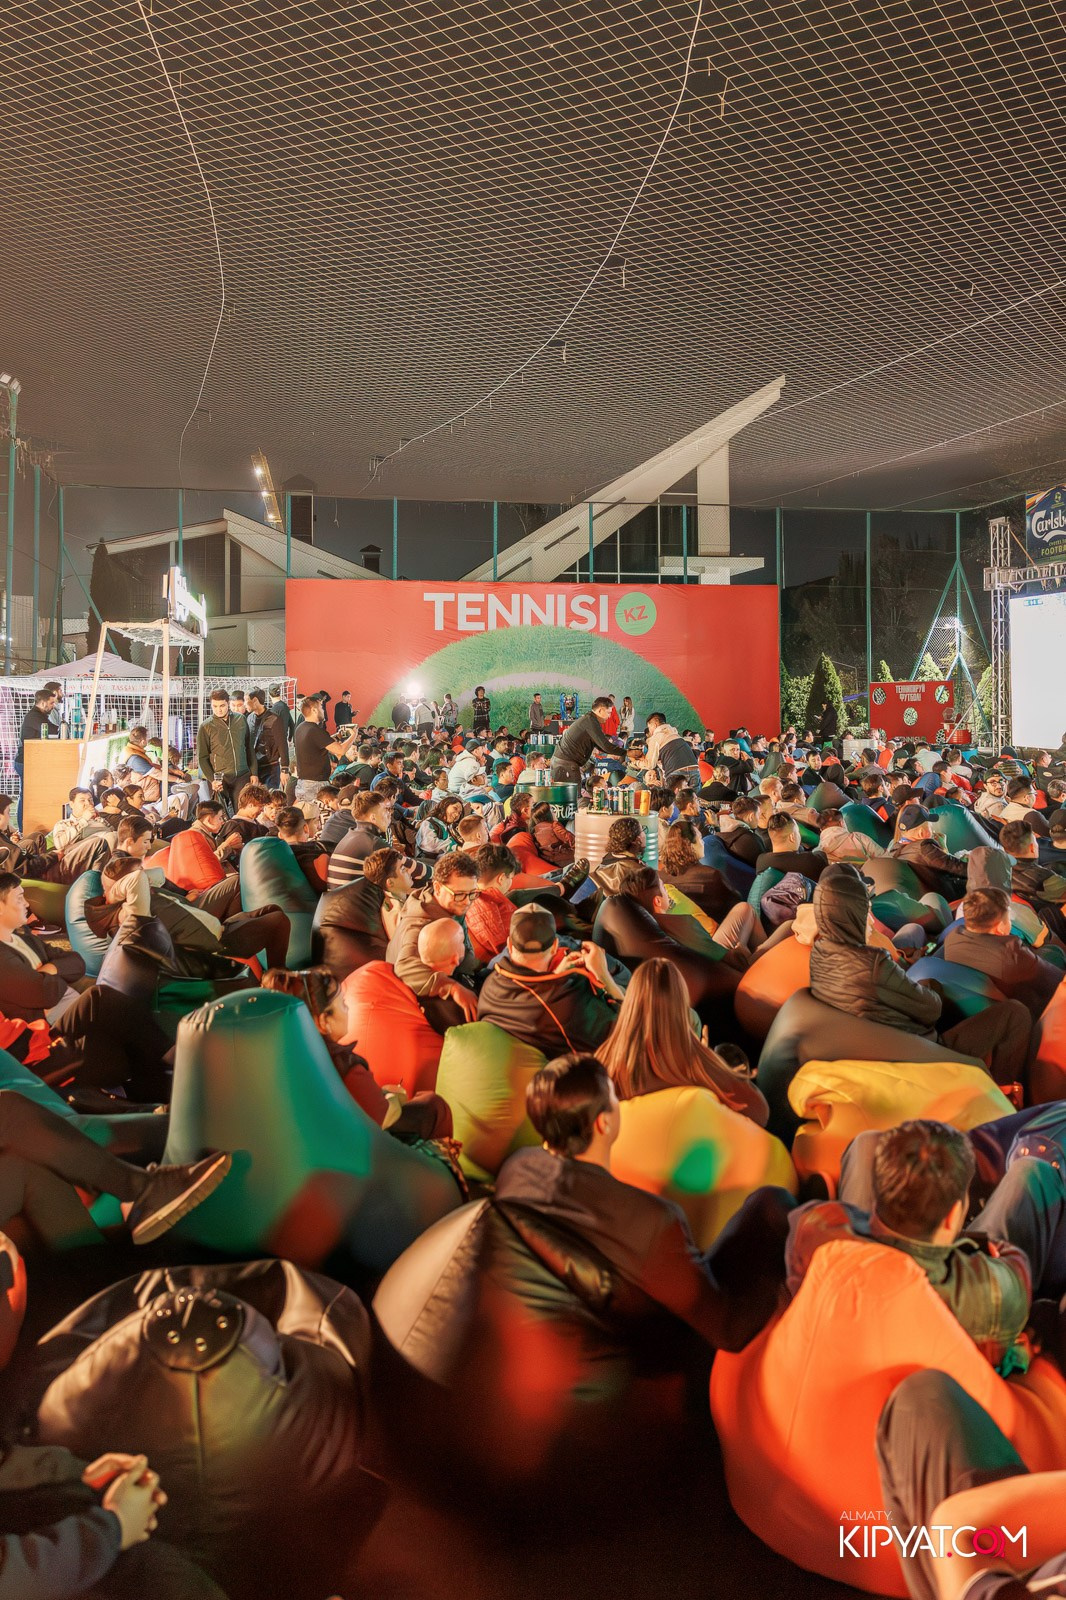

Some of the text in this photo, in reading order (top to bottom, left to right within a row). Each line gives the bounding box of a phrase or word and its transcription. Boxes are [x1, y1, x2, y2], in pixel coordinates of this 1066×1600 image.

[1031, 509, 1066, 538] Carlsb
[423, 592, 608, 632] TENNISI
[624, 605, 648, 623] KZ
